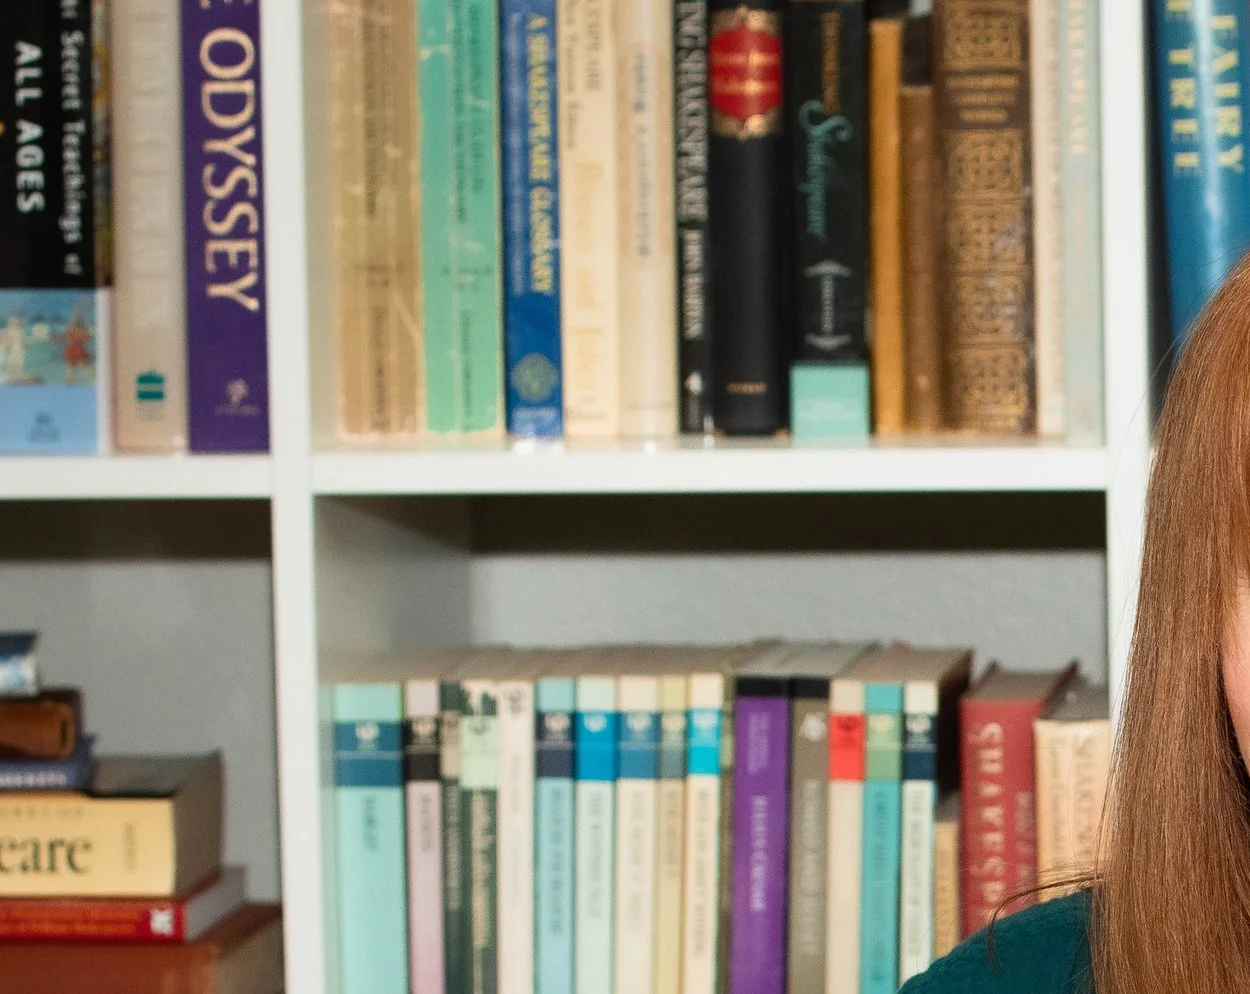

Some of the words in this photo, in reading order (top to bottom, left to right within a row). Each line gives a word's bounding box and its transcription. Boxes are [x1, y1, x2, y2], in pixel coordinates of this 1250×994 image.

[14, 40, 43, 107] ALL
[60, 29, 85, 111] Secret
[527, 33, 552, 182] SHAKESPEARE
[1167, 48, 1203, 179] TREE
[1208, 13, 1245, 175] FAIRY
[15, 119, 46, 215] AGES
[59, 119, 87, 245] Teachings
[199, 26, 260, 313] ODYSSEY
[676, 52, 709, 228] SHAKESPEARE
[0, 836, 93, 875] eare
